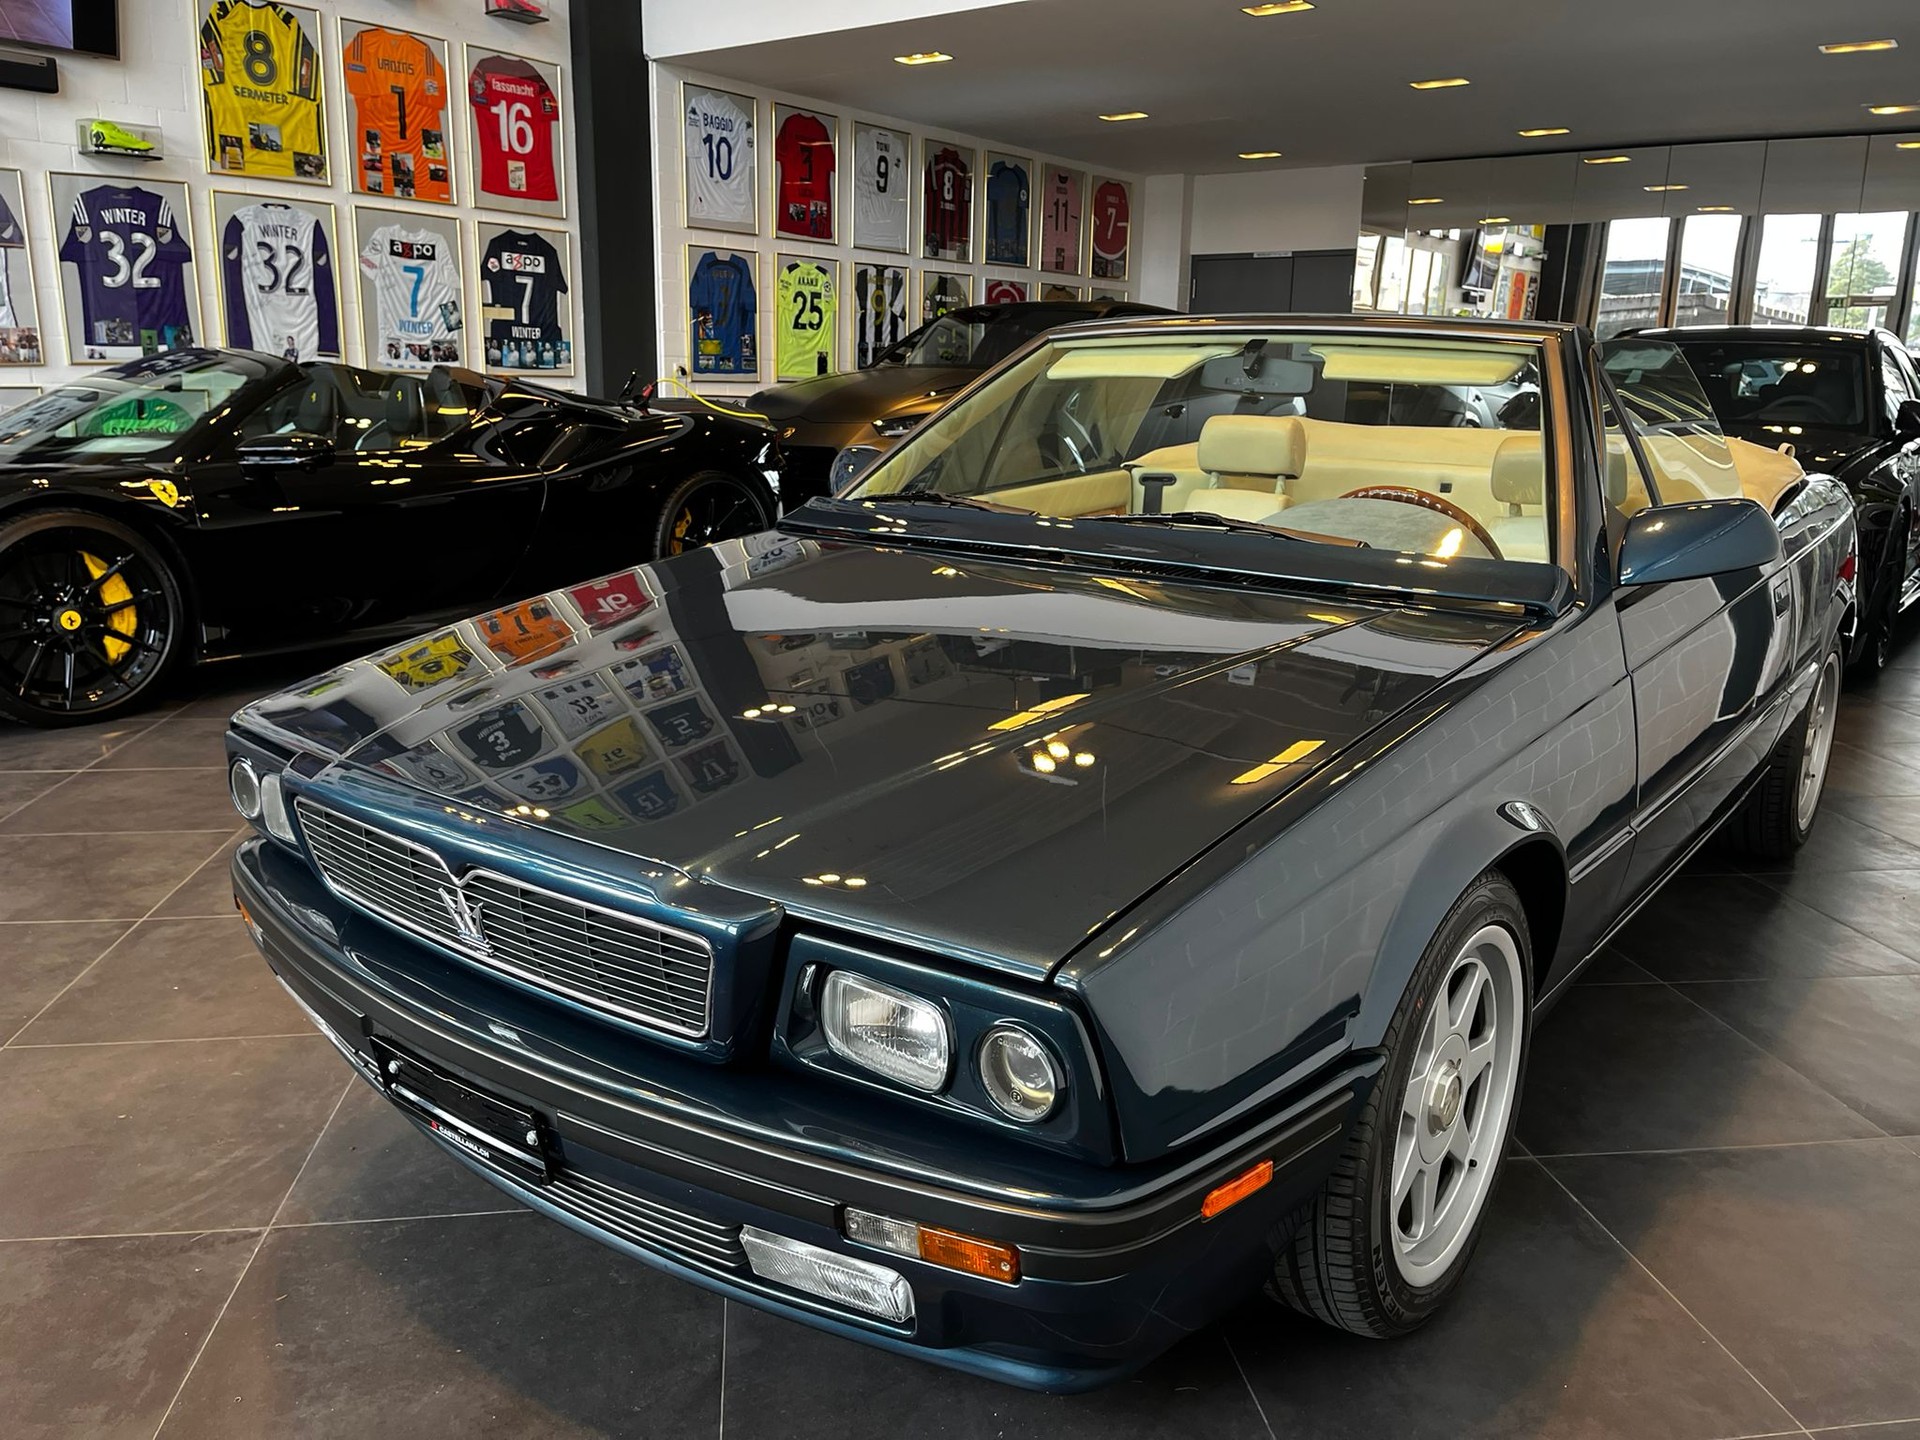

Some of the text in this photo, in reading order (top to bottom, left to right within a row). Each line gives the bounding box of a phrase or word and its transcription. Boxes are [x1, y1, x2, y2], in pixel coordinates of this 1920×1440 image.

[243, 29, 278, 87] 8
[390, 85, 407, 140] 1
[490, 99, 534, 155] 16
[703, 113, 733, 132] BAGGIO
[702, 133, 732, 180] 10
[876, 155, 889, 193] 9
[943, 170, 954, 200] 8
[100, 208, 147, 227] WINTER
[258, 224, 298, 241] WINTER
[1053, 198, 1068, 233] 11
[1107, 207, 1117, 240] 7
[99, 230, 162, 289] 32
[257, 241, 310, 296] 32
[403, 265, 424, 318] 7
[515, 275, 534, 325] 7
[792, 290, 824, 331] 25
[870, 288, 887, 327] 9
[399, 319, 434, 335] WINTER
[511, 325, 541, 340] WINTER
[1372, 1243, 1406, 1321] NEXEN
